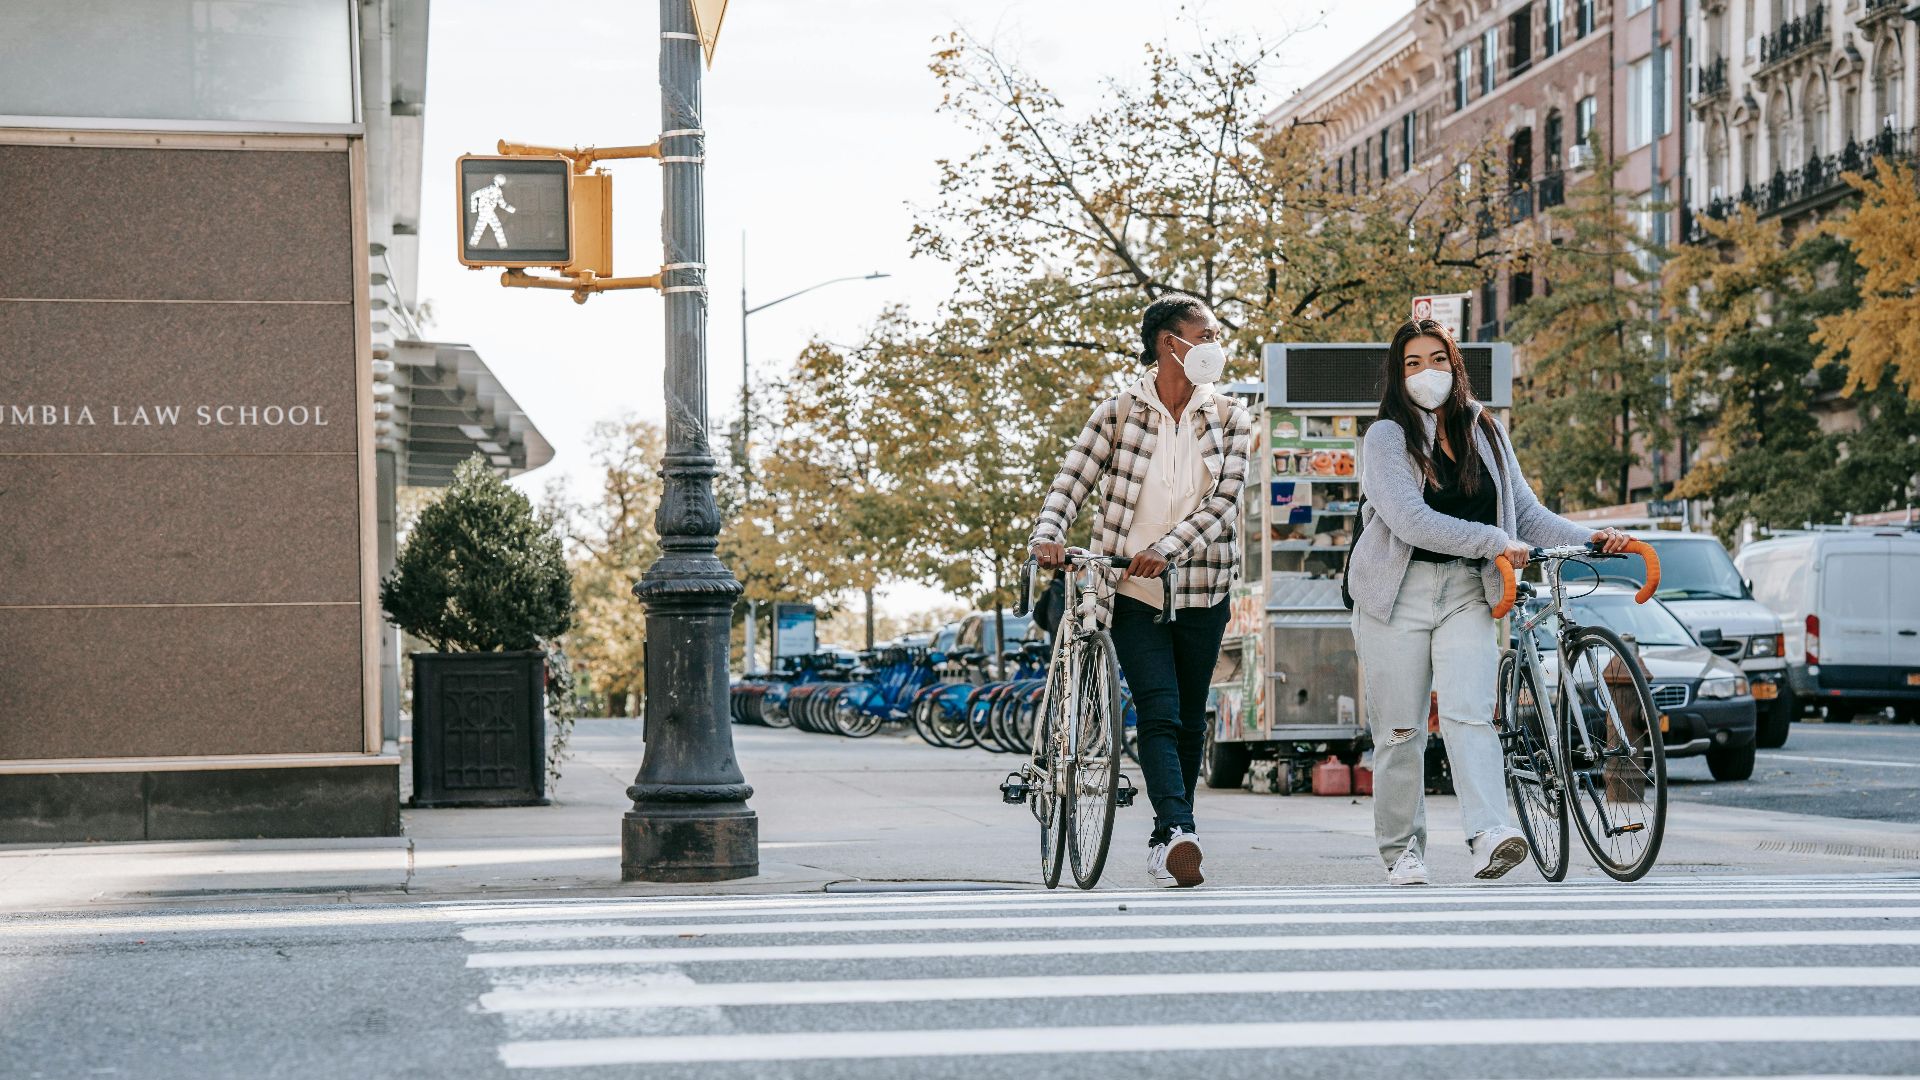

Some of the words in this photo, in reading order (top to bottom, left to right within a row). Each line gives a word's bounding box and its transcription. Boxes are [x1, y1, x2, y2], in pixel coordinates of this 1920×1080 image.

[0, 405, 96, 425] MBIA
[113, 405, 181, 425] LAW
[197, 405, 329, 426] SCHOOL
